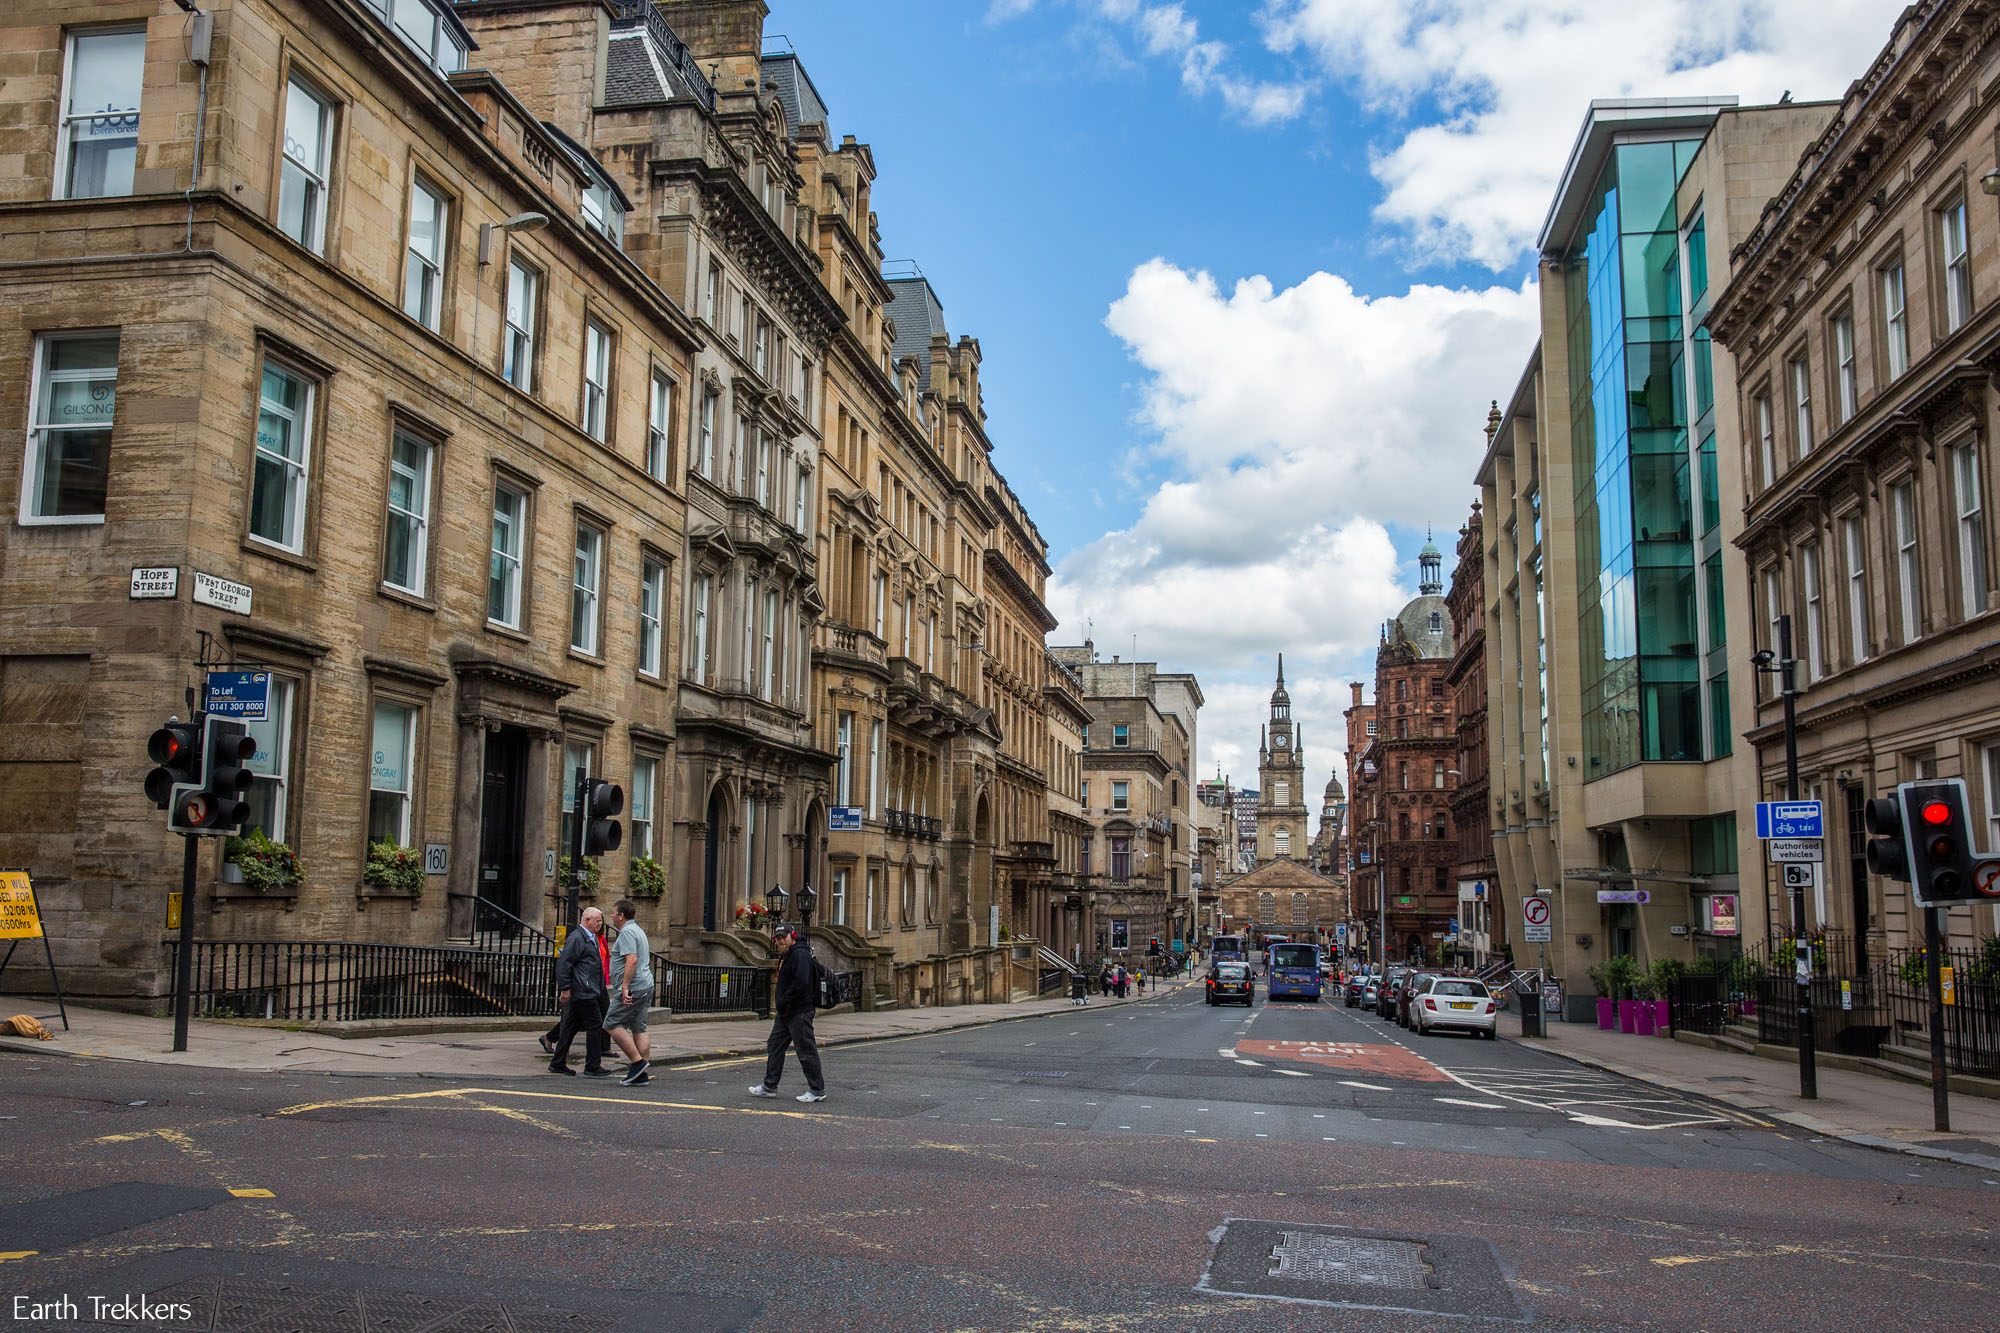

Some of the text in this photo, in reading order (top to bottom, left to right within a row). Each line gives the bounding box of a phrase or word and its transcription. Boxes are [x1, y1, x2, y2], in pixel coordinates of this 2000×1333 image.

[140, 570, 169, 580] HOPE
[133, 581, 175, 591] STREET
[197, 574, 251, 598] WEST GEORGE
[209, 588, 239, 605] STREET
[211, 687, 233, 695] To Let
[210, 702, 264, 711] 0141 300 8000
[1799, 823, 1815, 831] taxi
[1773, 842, 1819, 850] Authorised
[427, 848, 447, 870] 160
[11, 879, 28, 889] WILL
[16, 892, 31, 902] FOR
[3, 905, 36, 916] 02/08/16
